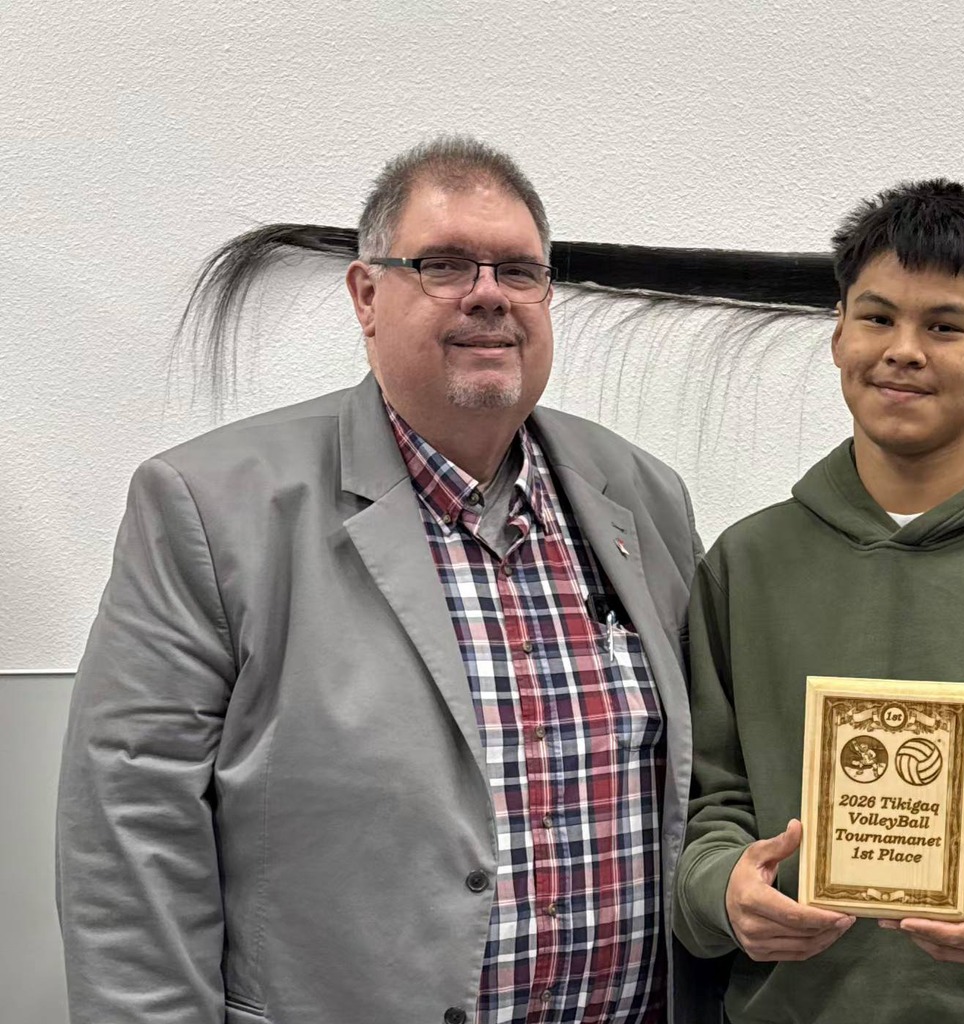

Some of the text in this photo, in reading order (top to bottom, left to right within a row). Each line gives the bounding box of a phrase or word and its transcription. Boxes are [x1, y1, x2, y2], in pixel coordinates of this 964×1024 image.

[886, 711, 903, 722] 1st
[839, 794, 940, 816] 2026 Tikigaq
[848, 811, 930, 830] VolleyBall
[835, 828, 942, 847] Tournamanet
[851, 846, 923, 863] 1st Place
